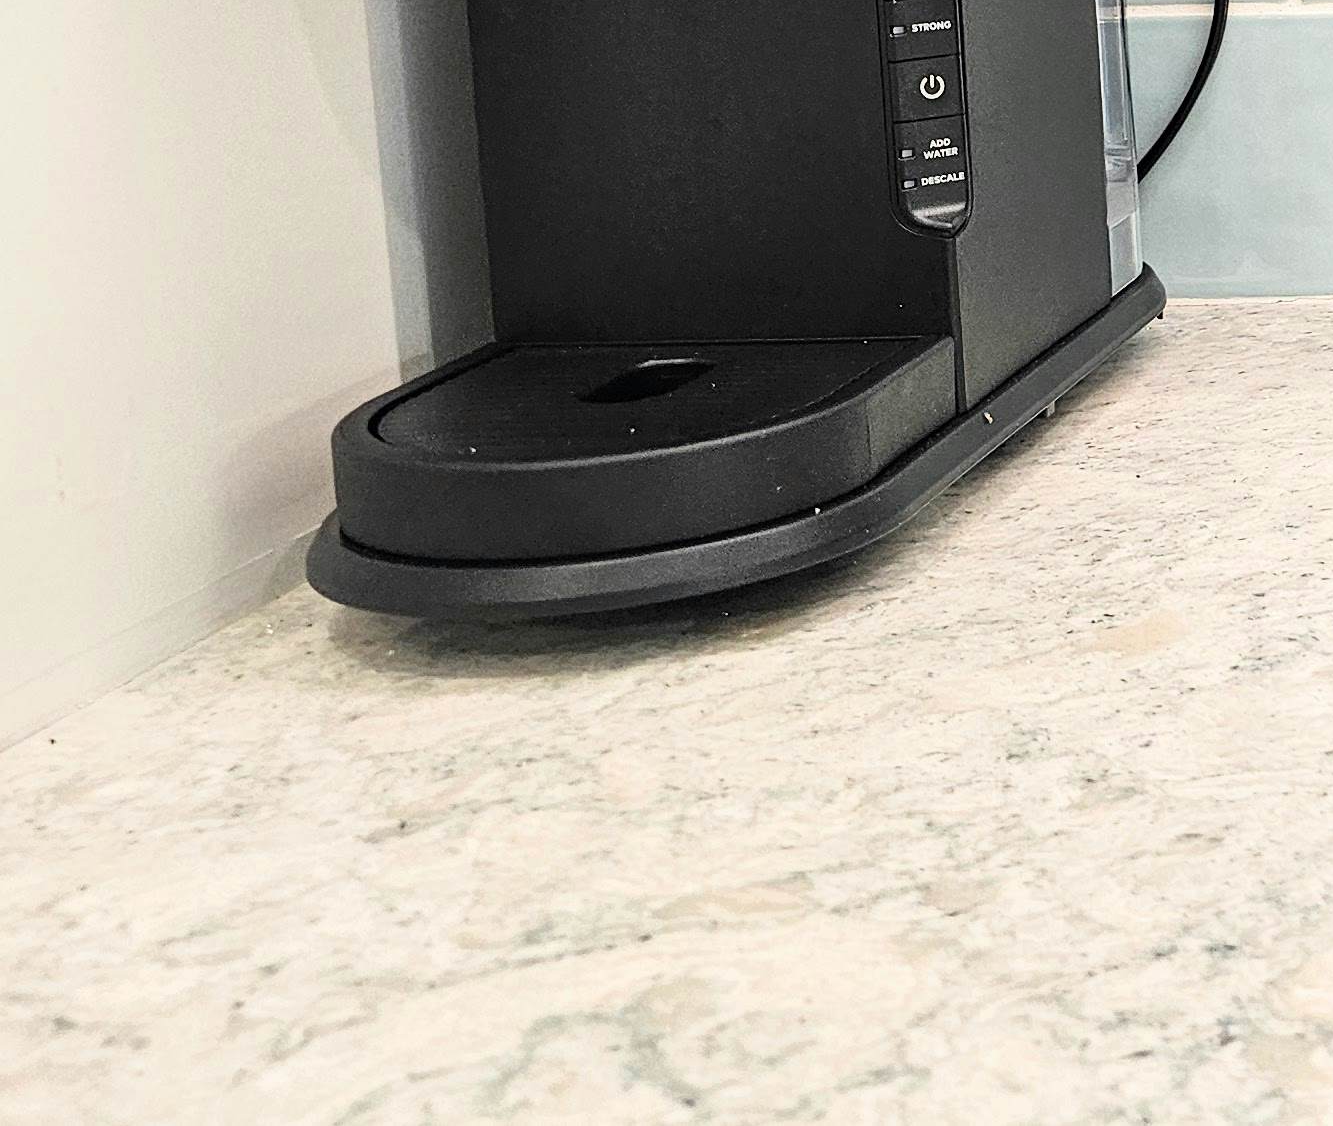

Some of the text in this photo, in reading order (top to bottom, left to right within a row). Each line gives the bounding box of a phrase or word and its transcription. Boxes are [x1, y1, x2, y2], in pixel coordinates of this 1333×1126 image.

[911, 20, 952, 33] STRONG
[929, 137, 951, 149] ADD
[923, 146, 959, 160] WATER
[920, 171, 966, 187] DESCALE
